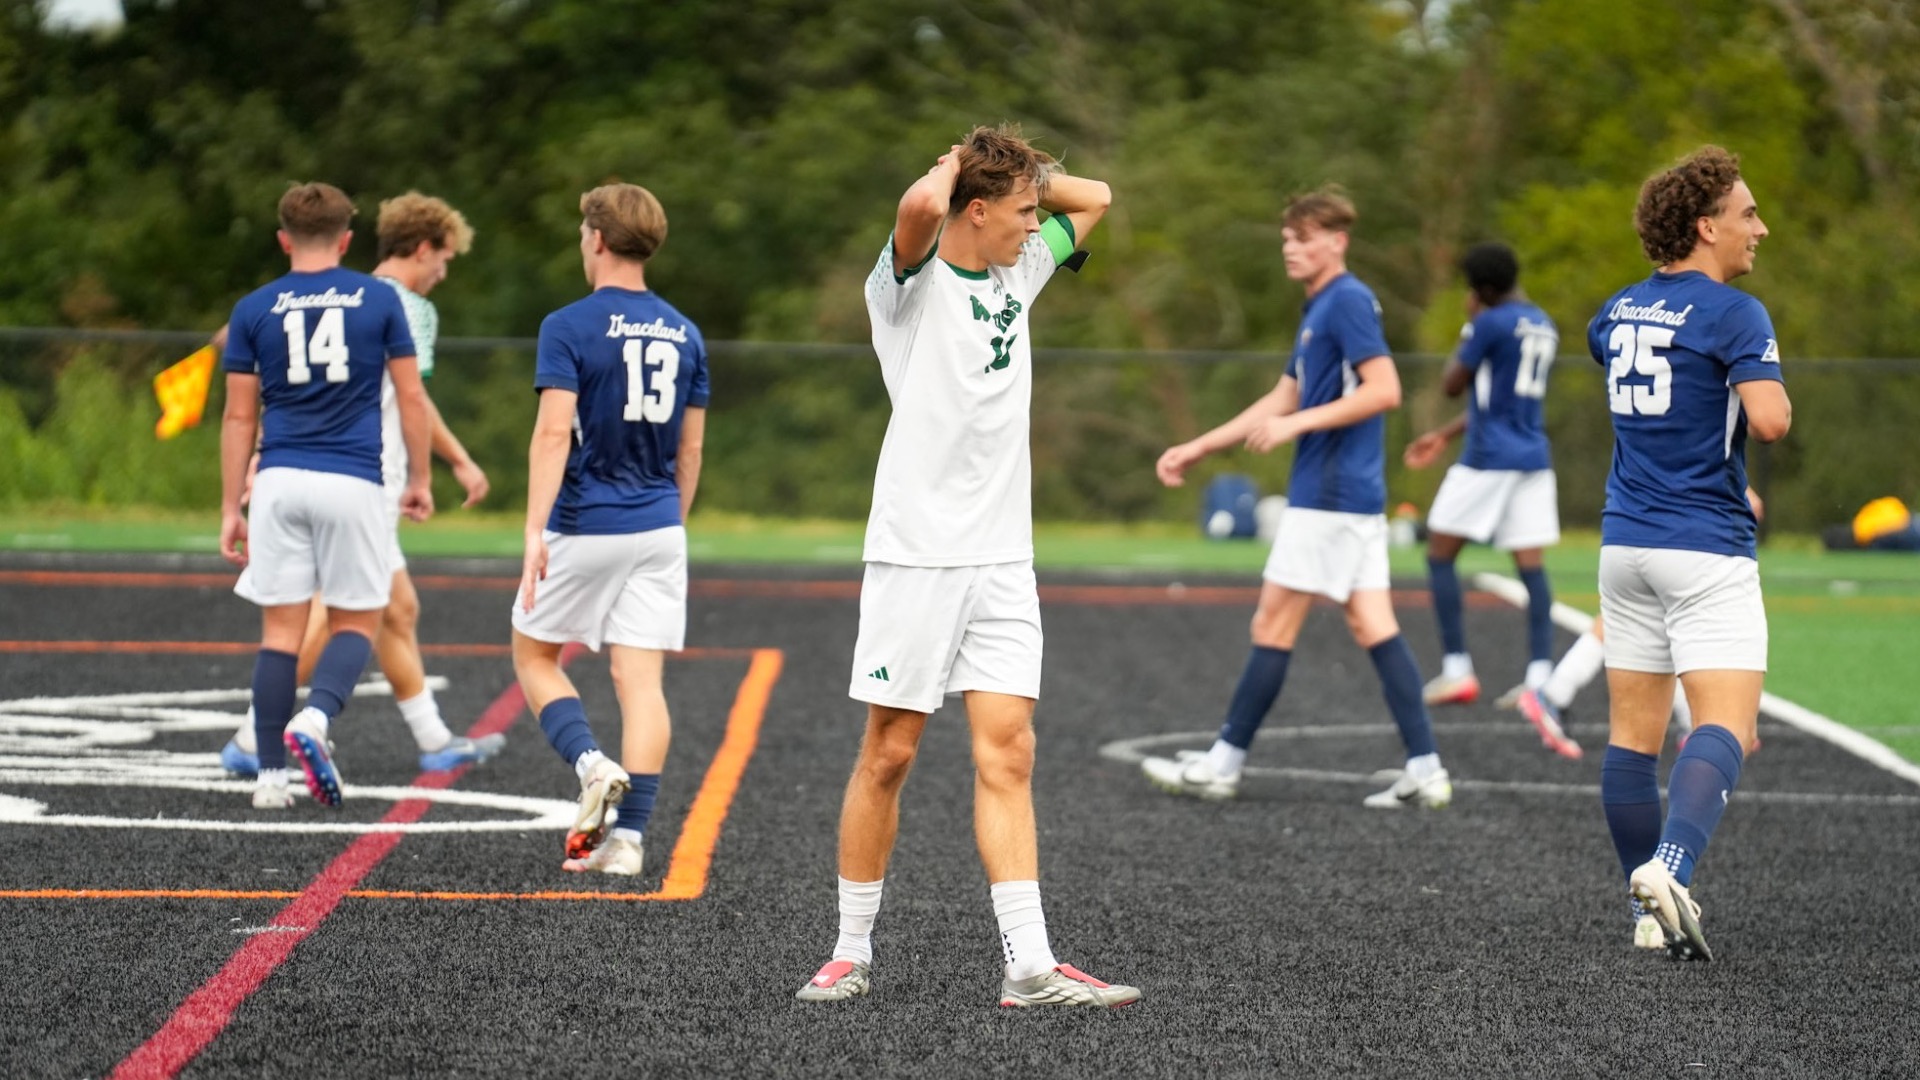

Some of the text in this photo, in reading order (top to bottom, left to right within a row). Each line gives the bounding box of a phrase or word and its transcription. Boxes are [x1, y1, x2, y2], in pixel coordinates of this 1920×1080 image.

[270, 286, 365, 314] Graceland
[1608, 298, 1693, 327] Graceland
[283, 307, 350, 385] 14
[606, 314, 688, 343] Graceland
[622, 339, 680, 424] 13
[1608, 324, 1676, 416] 25
